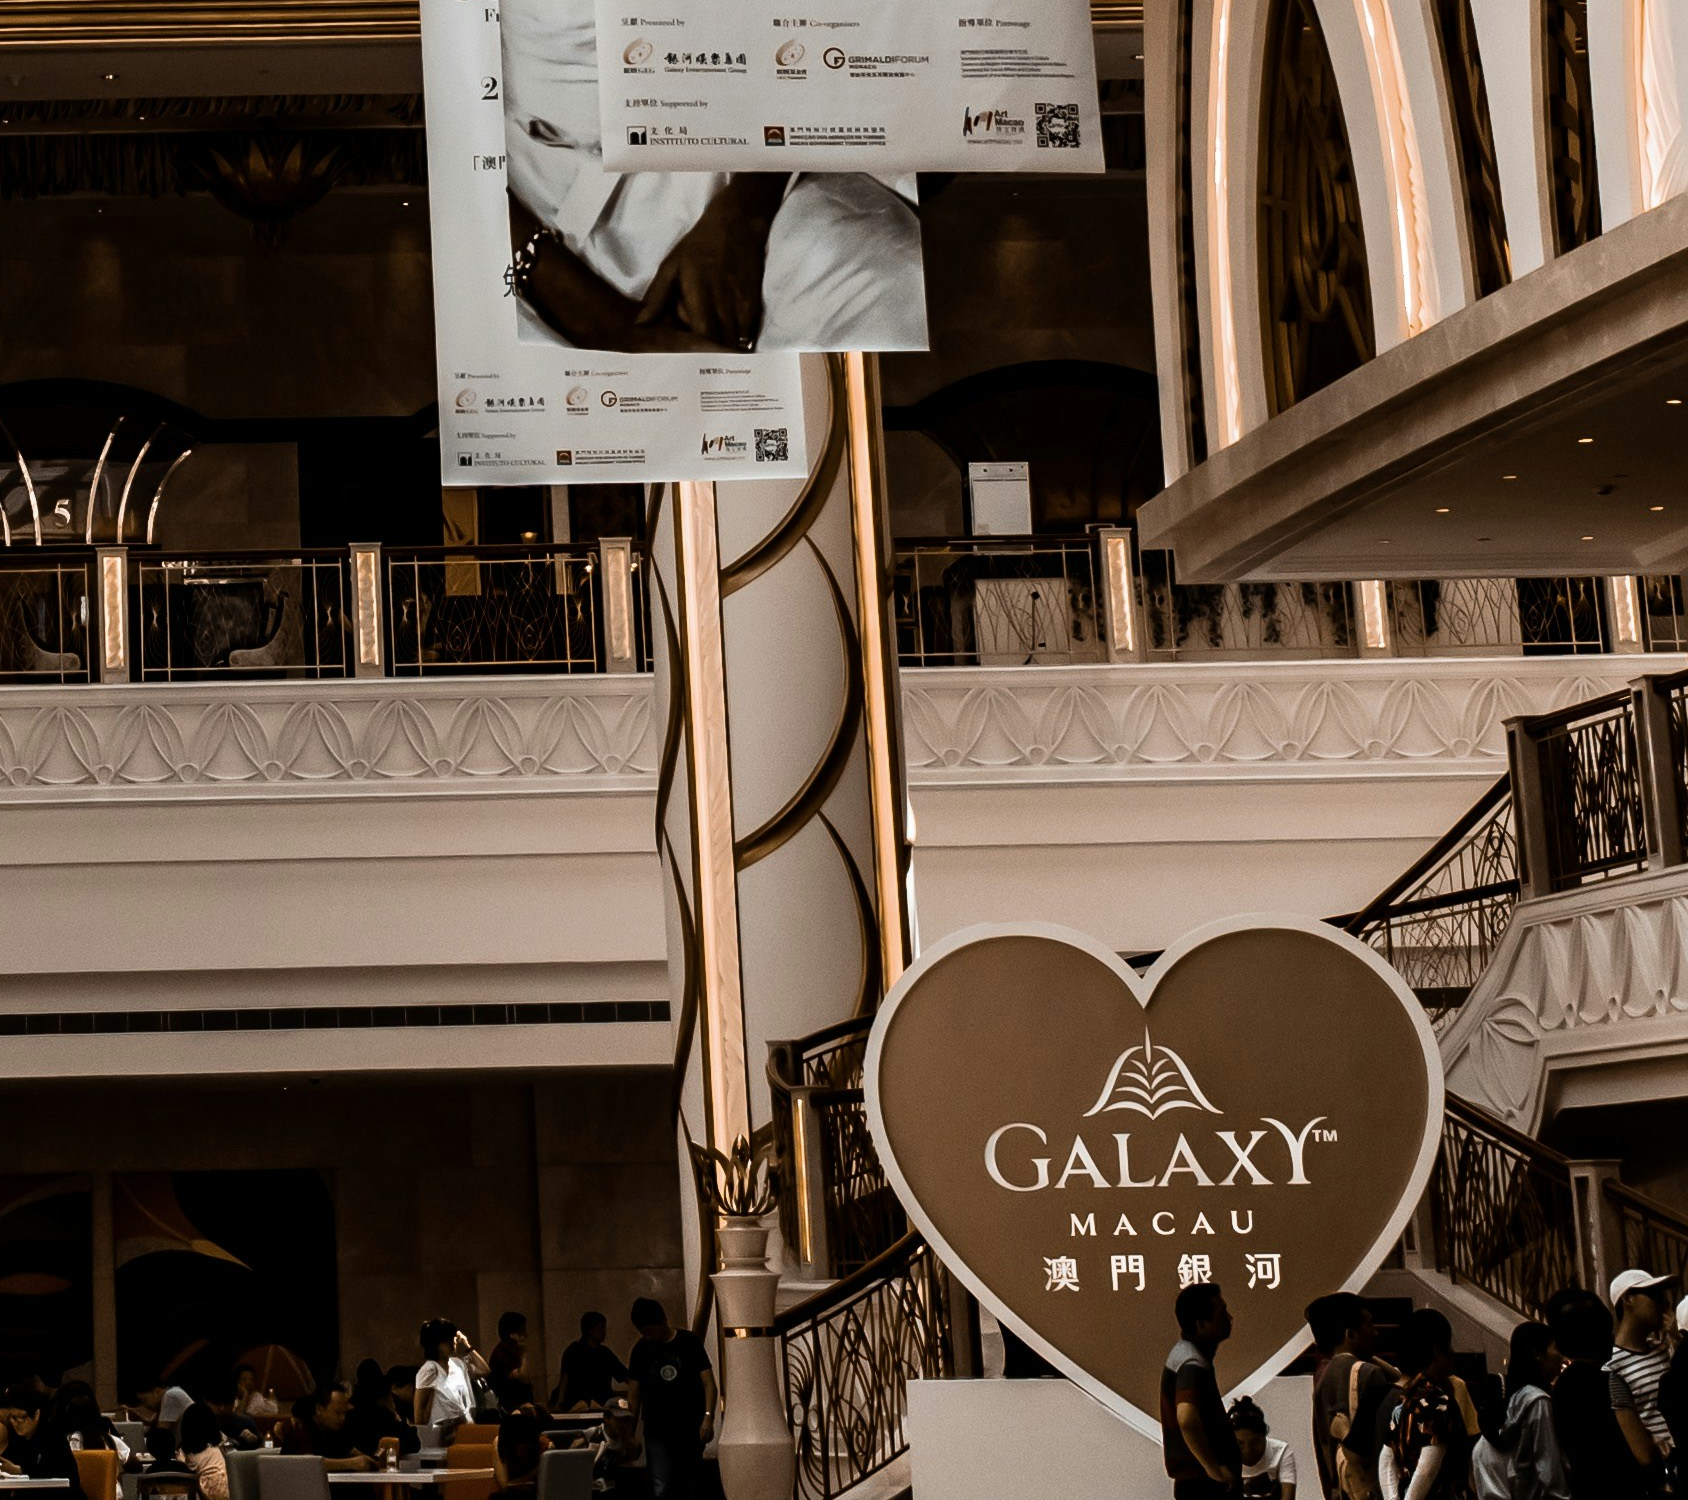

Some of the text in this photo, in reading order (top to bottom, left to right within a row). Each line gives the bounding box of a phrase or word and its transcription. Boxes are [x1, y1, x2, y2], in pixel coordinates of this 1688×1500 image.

[994, 110, 1008, 118] Art
[650, 137, 749, 145] INSTITUTO CULTURAL
[54, 499, 71, 528] 5
[1070, 1210, 1254, 1237] MACAU
[1044, 1253, 1282, 1292] 澳門銀河
